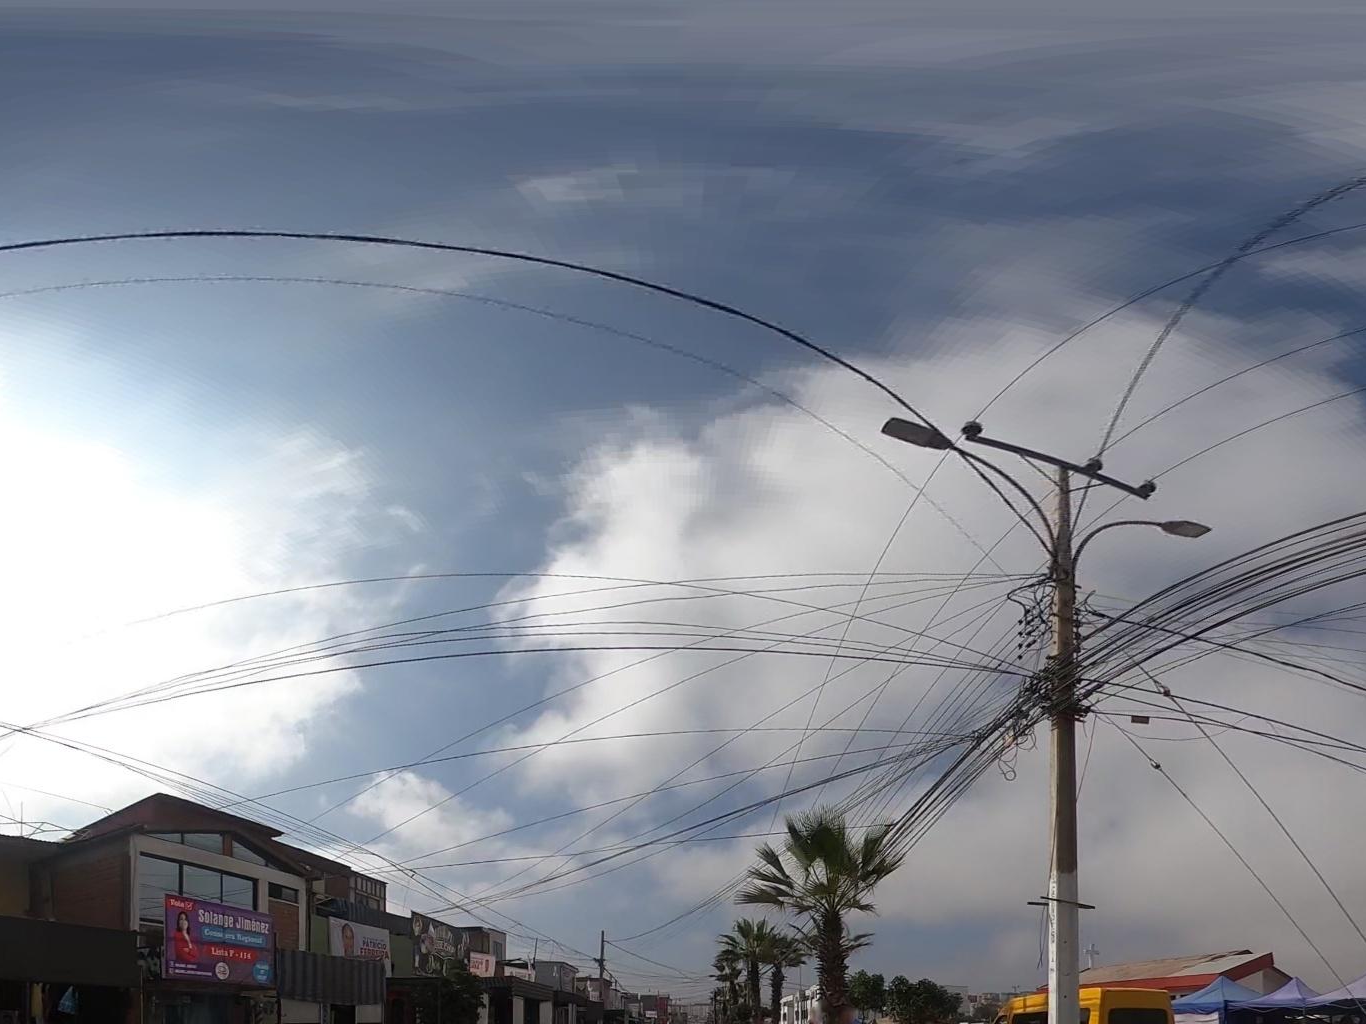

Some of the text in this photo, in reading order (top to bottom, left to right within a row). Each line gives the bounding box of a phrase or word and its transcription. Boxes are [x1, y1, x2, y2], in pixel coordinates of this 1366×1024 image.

[198, 909, 234, 928] Solange
[362, 938, 387, 950] PATRICIO
[211, 947, 228, 957] Lista
